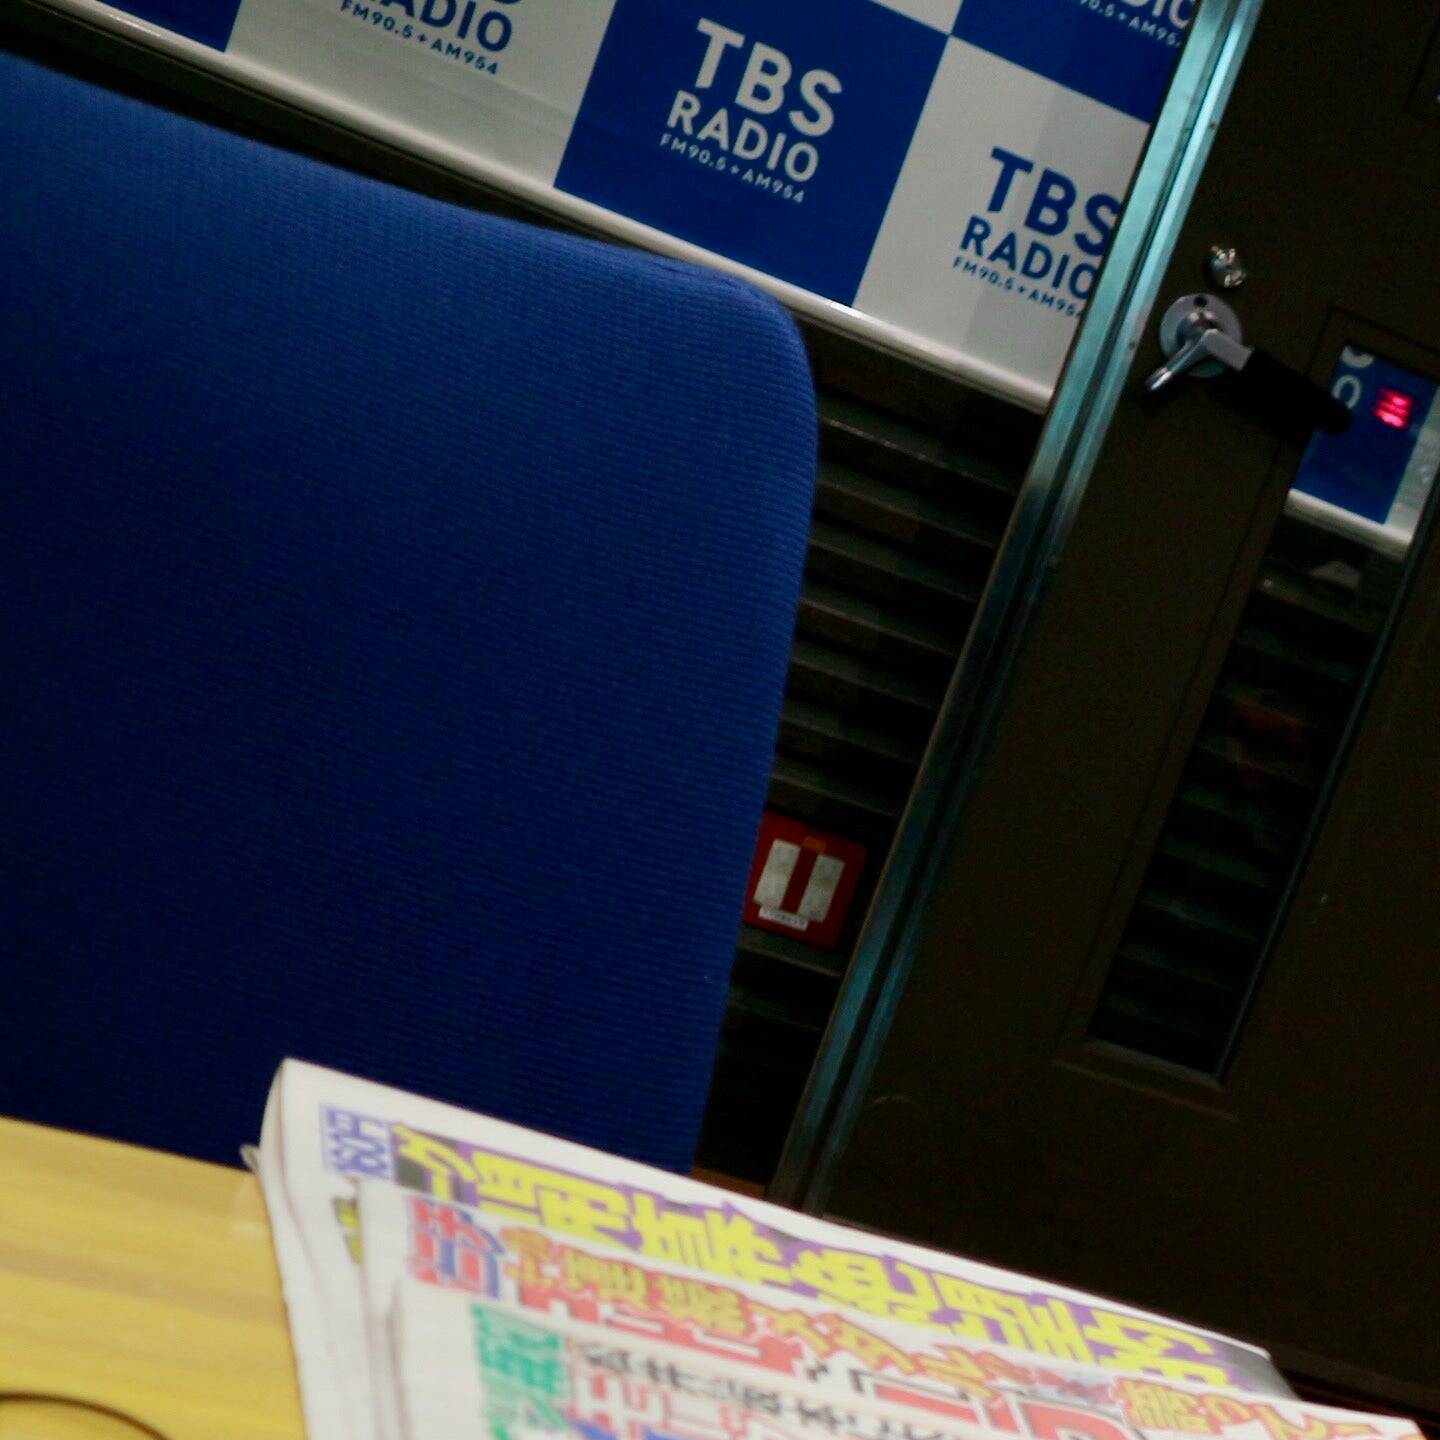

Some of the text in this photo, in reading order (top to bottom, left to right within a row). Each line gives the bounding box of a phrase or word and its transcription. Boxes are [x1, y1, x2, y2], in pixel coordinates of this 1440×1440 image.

[695, 17, 843, 137] TBS
[666, 89, 819, 183] RADIO
[986, 146, 1122, 257] TBS
[960, 213, 1099, 300] RADIO
